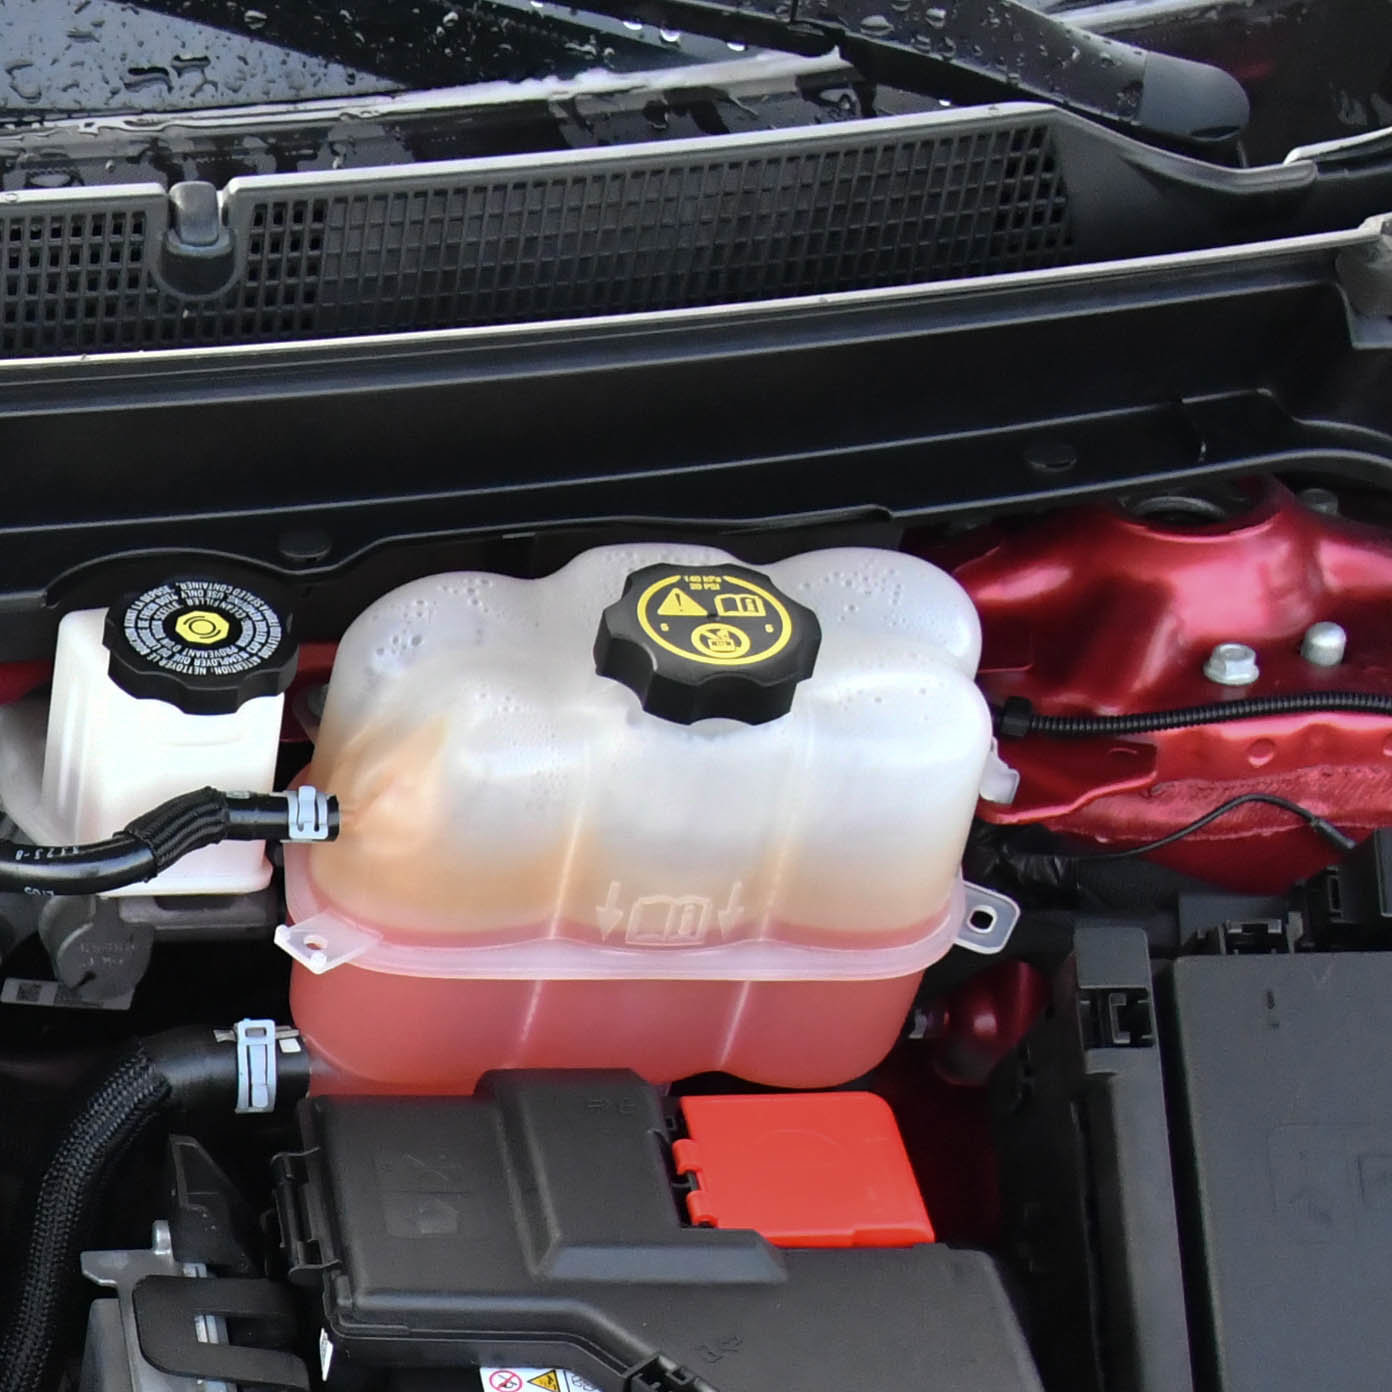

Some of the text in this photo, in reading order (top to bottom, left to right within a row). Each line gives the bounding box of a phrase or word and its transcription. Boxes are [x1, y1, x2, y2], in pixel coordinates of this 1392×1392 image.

[176, 589, 203, 597] ONLY
[231, 588, 266, 607] SEALED
[184, 597, 220, 606] FILLER
[171, 653, 191, 664] QUE
[158, 658, 207, 674] NETTOYER
